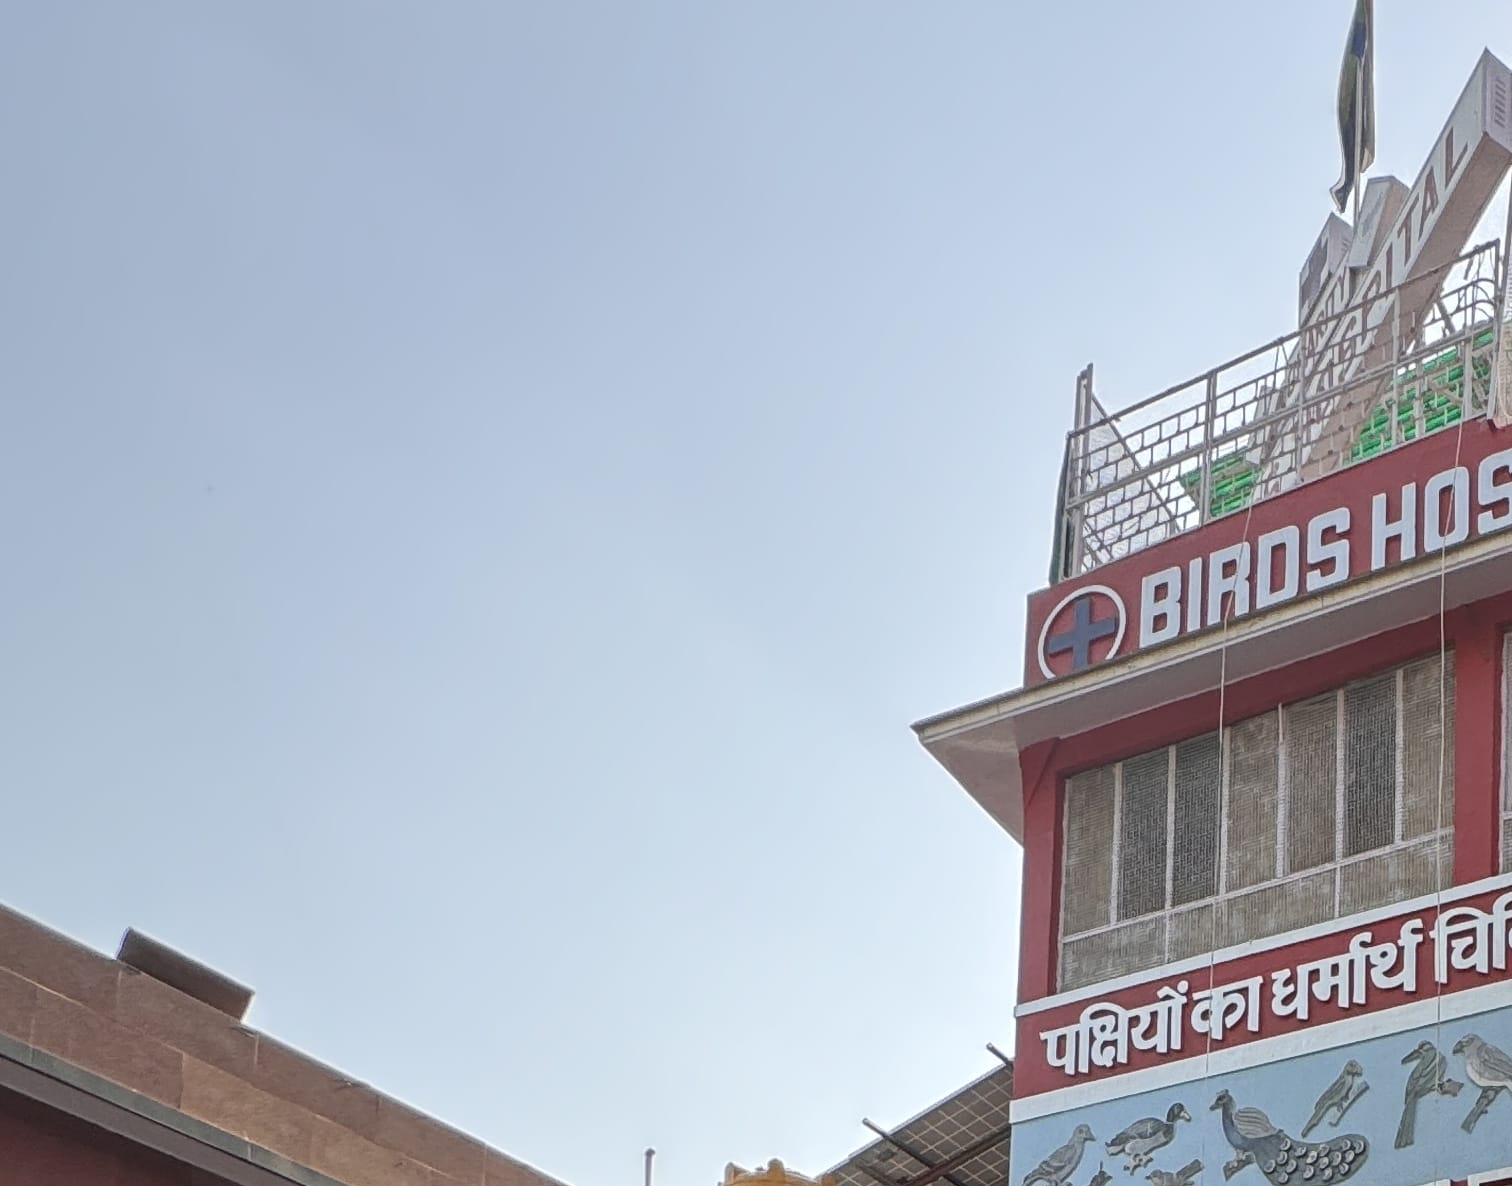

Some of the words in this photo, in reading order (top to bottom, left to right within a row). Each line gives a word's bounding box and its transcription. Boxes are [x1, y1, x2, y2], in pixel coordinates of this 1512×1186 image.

[1139, 509, 1352, 648] BIRDS
[1041, 981, 1190, 1076] पक्षियों
[1191, 976, 1262, 1040] का
[1272, 918, 1426, 1020] धर्मार्थ
